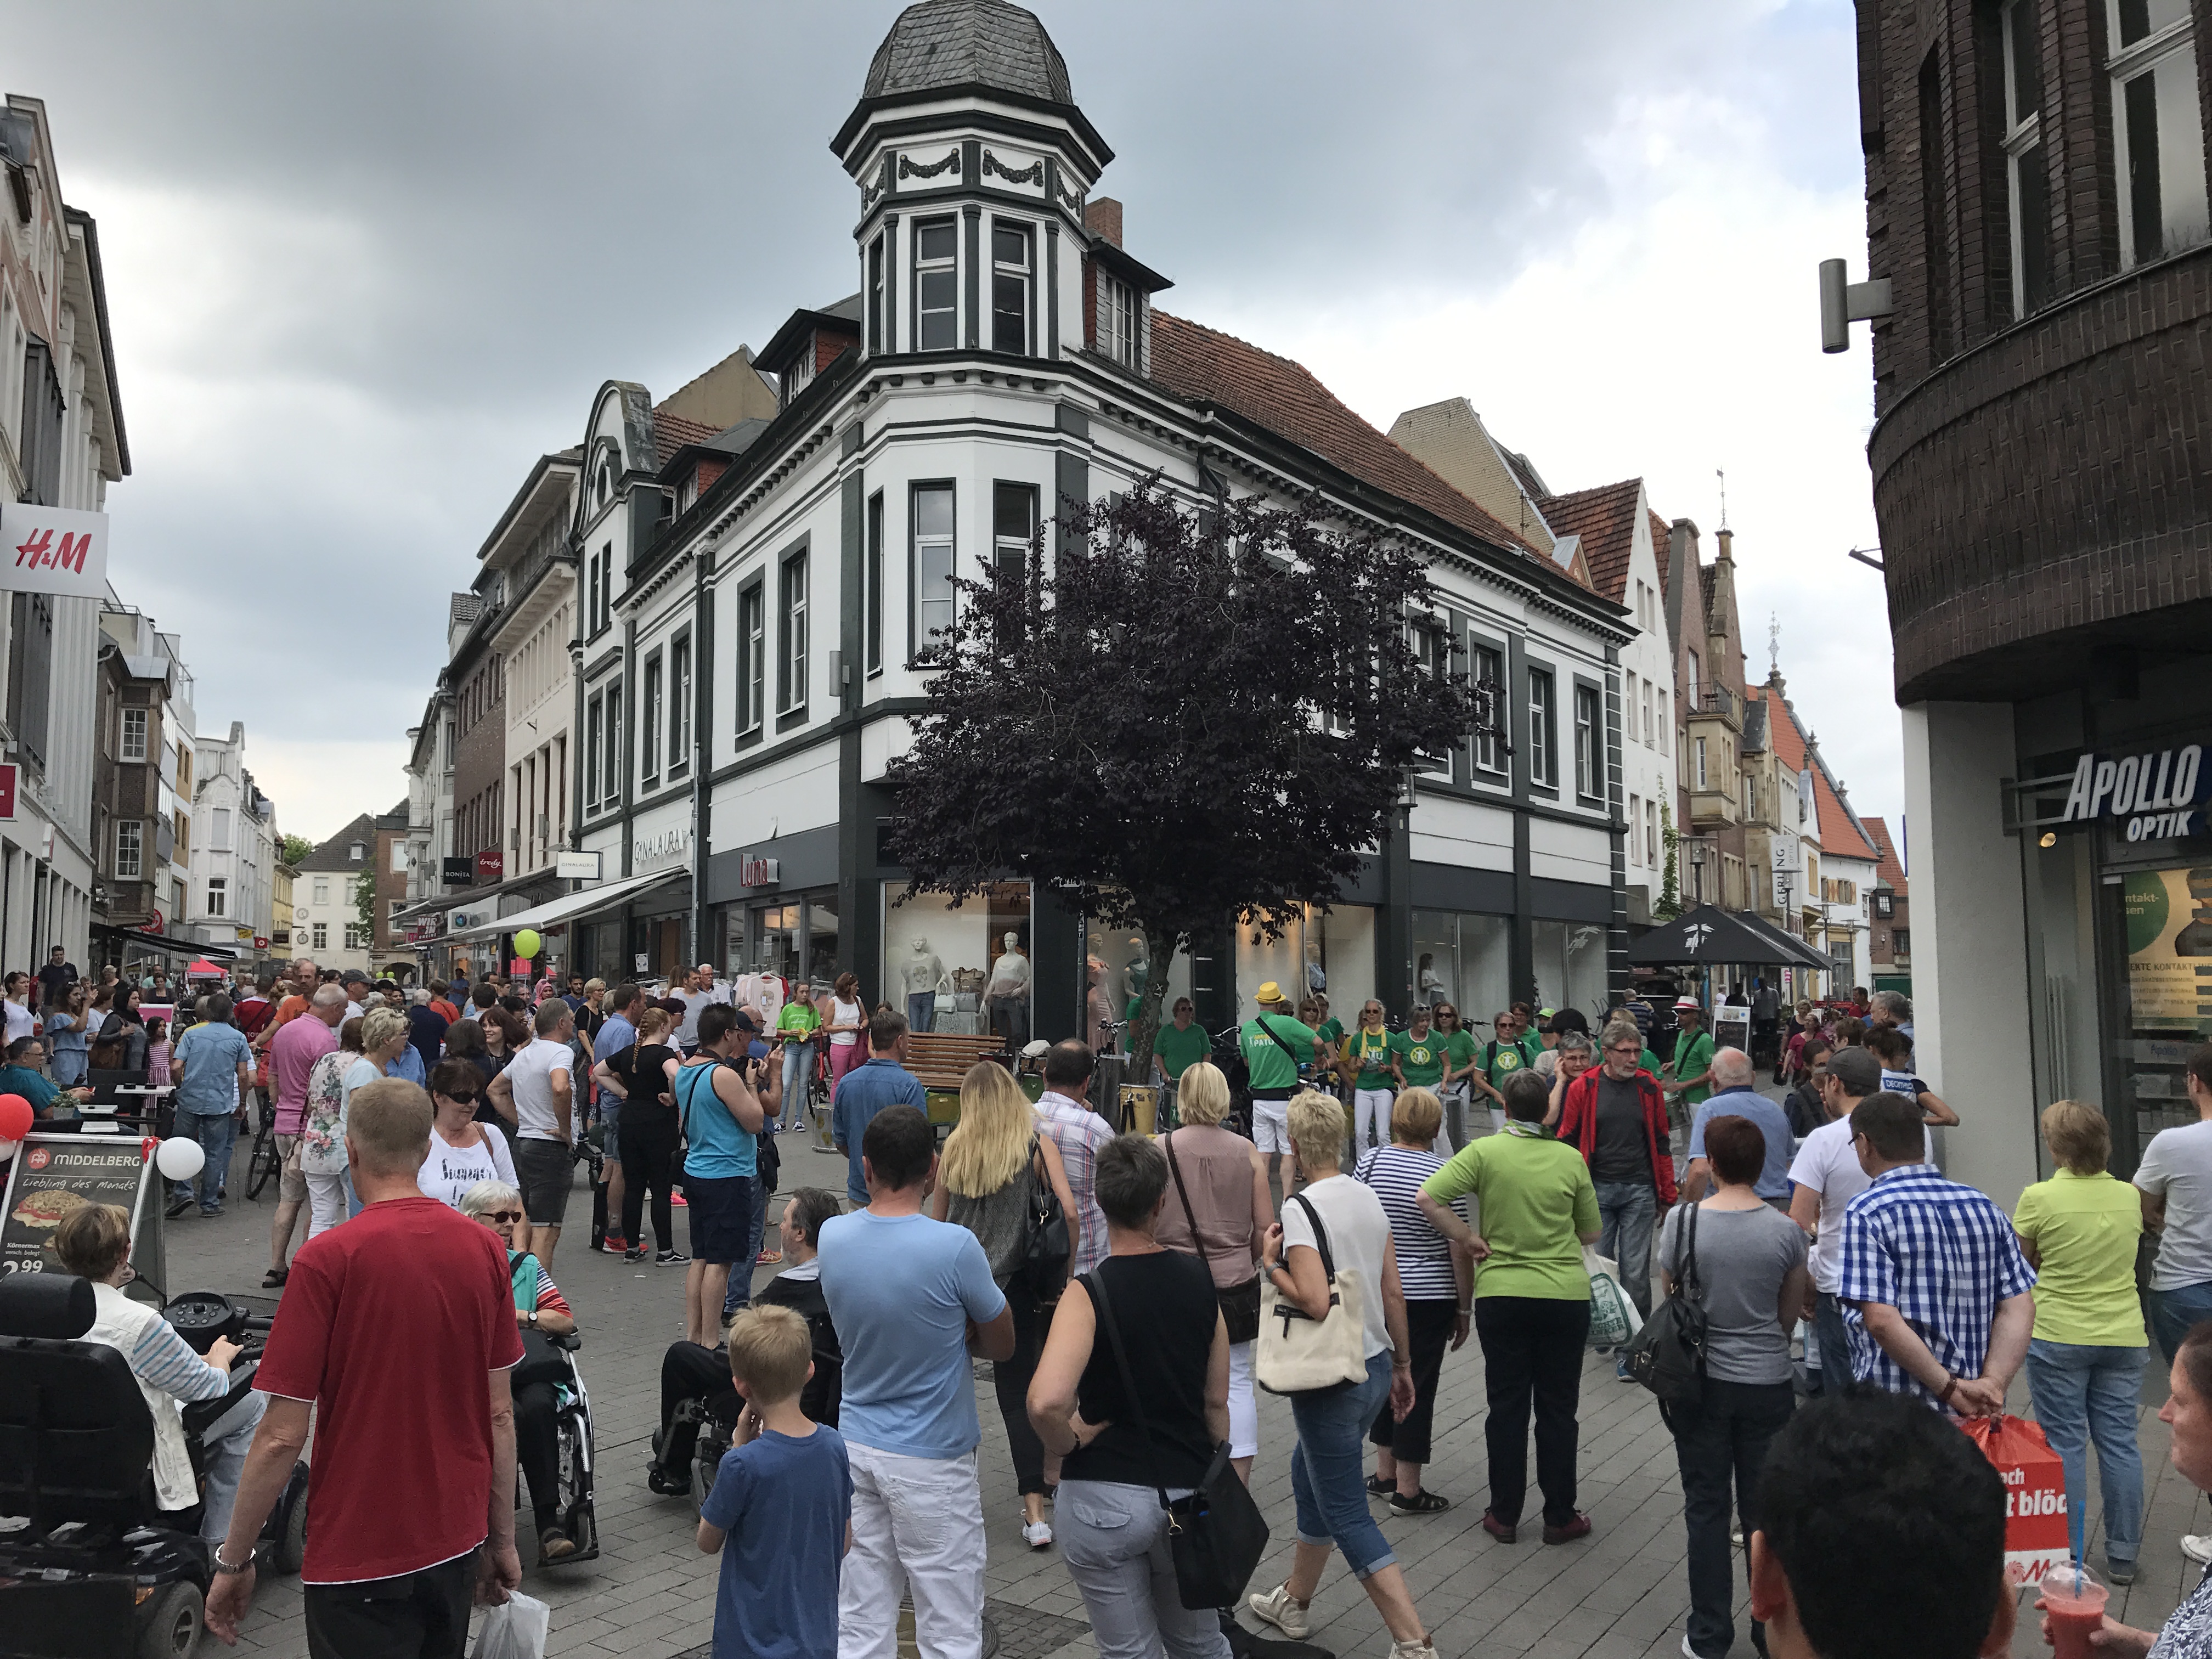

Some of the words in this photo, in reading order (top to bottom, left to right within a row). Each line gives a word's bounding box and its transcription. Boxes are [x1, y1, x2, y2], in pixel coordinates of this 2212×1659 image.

[16, 528, 92, 574] H&M
[2063, 744, 2202, 821] APOLLO
[2127, 810, 2194, 842] OPTIK
[479, 858, 501, 868] tredy
[741, 853, 768, 887] Luna
[419, 917, 437, 926] WIR
[54, 1154, 140, 1167] MIDDELBERG
[22, 1178, 67, 1189] Liebling
[72, 1180, 92, 1188] des
